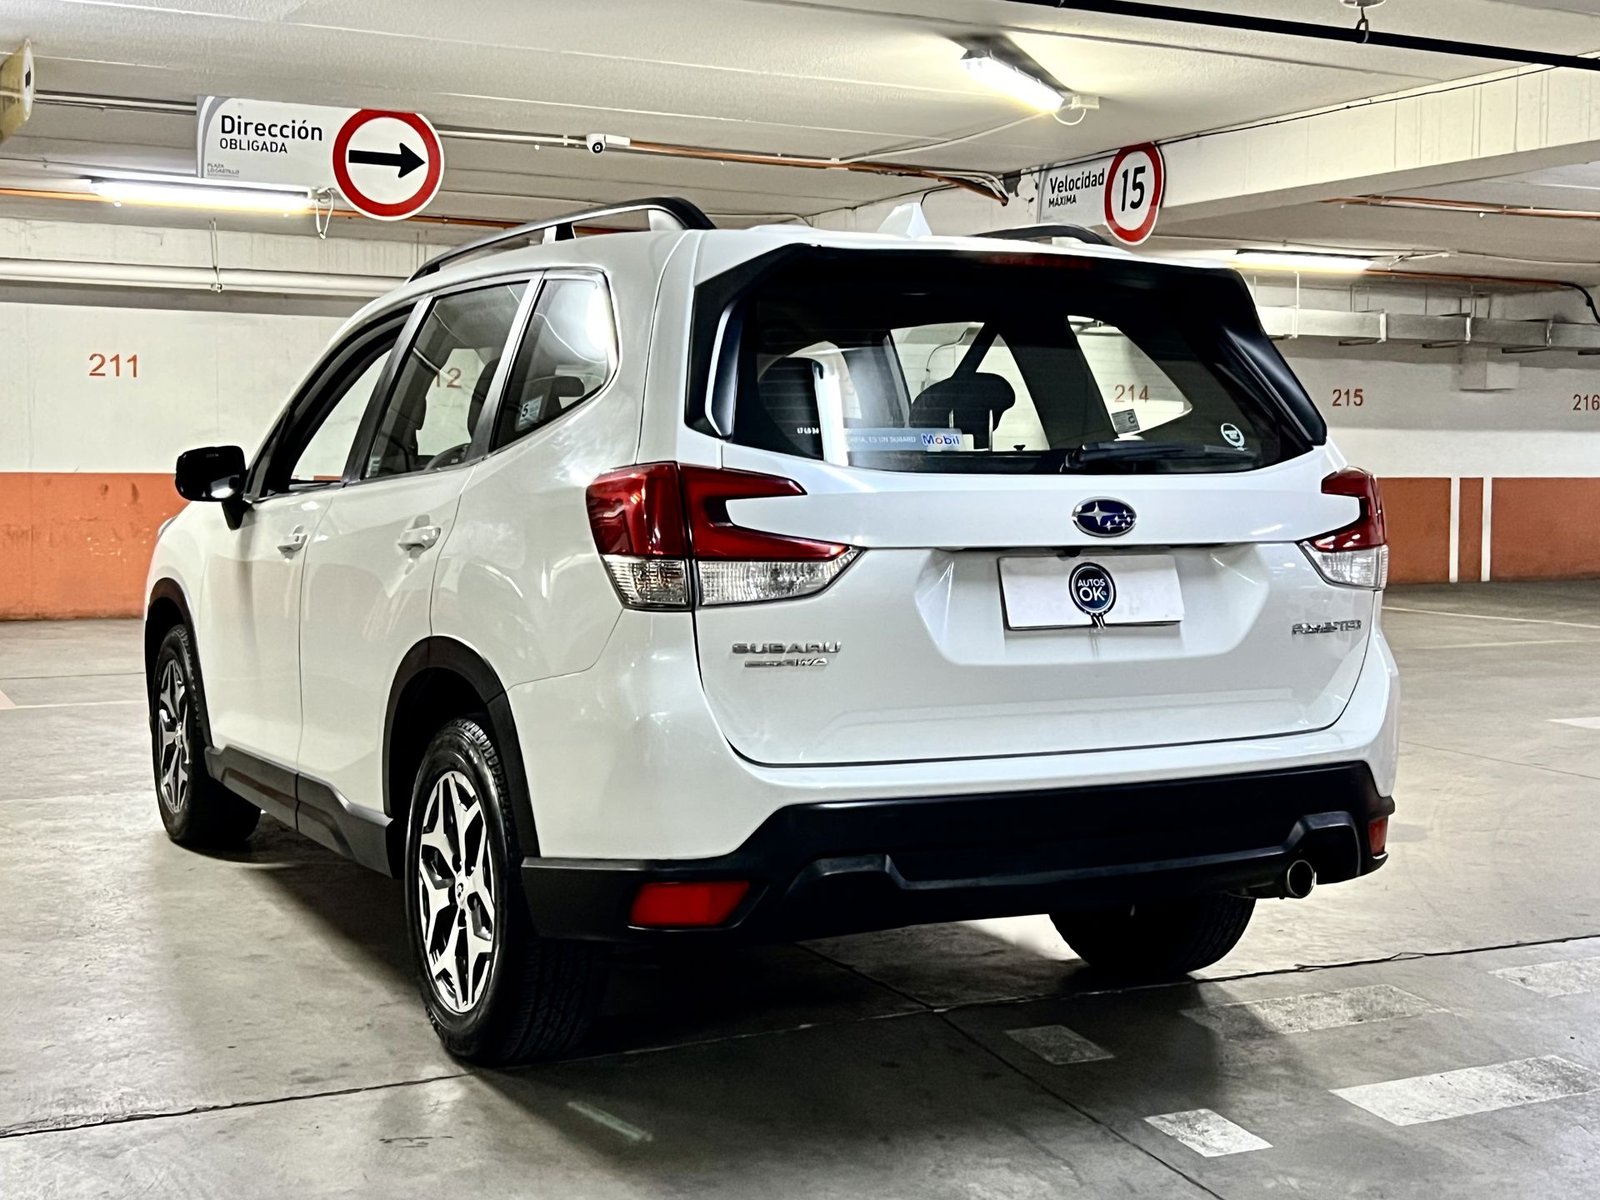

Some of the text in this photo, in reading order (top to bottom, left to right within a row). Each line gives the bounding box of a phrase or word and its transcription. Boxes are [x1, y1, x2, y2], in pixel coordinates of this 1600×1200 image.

[221, 114, 323, 142] Dirección
[219, 138, 288, 154] OBLIGADA
[1050, 167, 1105, 194] Velocidad
[1121, 165, 1146, 212] 15
[1048, 194, 1077, 208] MÁXIMA
[88, 352, 138, 378] 211
[1114, 384, 1150, 403] 214
[1332, 388, 1364, 407] 215
[1572, 394, 1600, 410] 216
[922, 433, 960, 445] Mobil
[1077, 578, 1106, 587] AUTOS
[1079, 587, 1106, 601] OK
[731, 641, 841, 654] SUBARU
